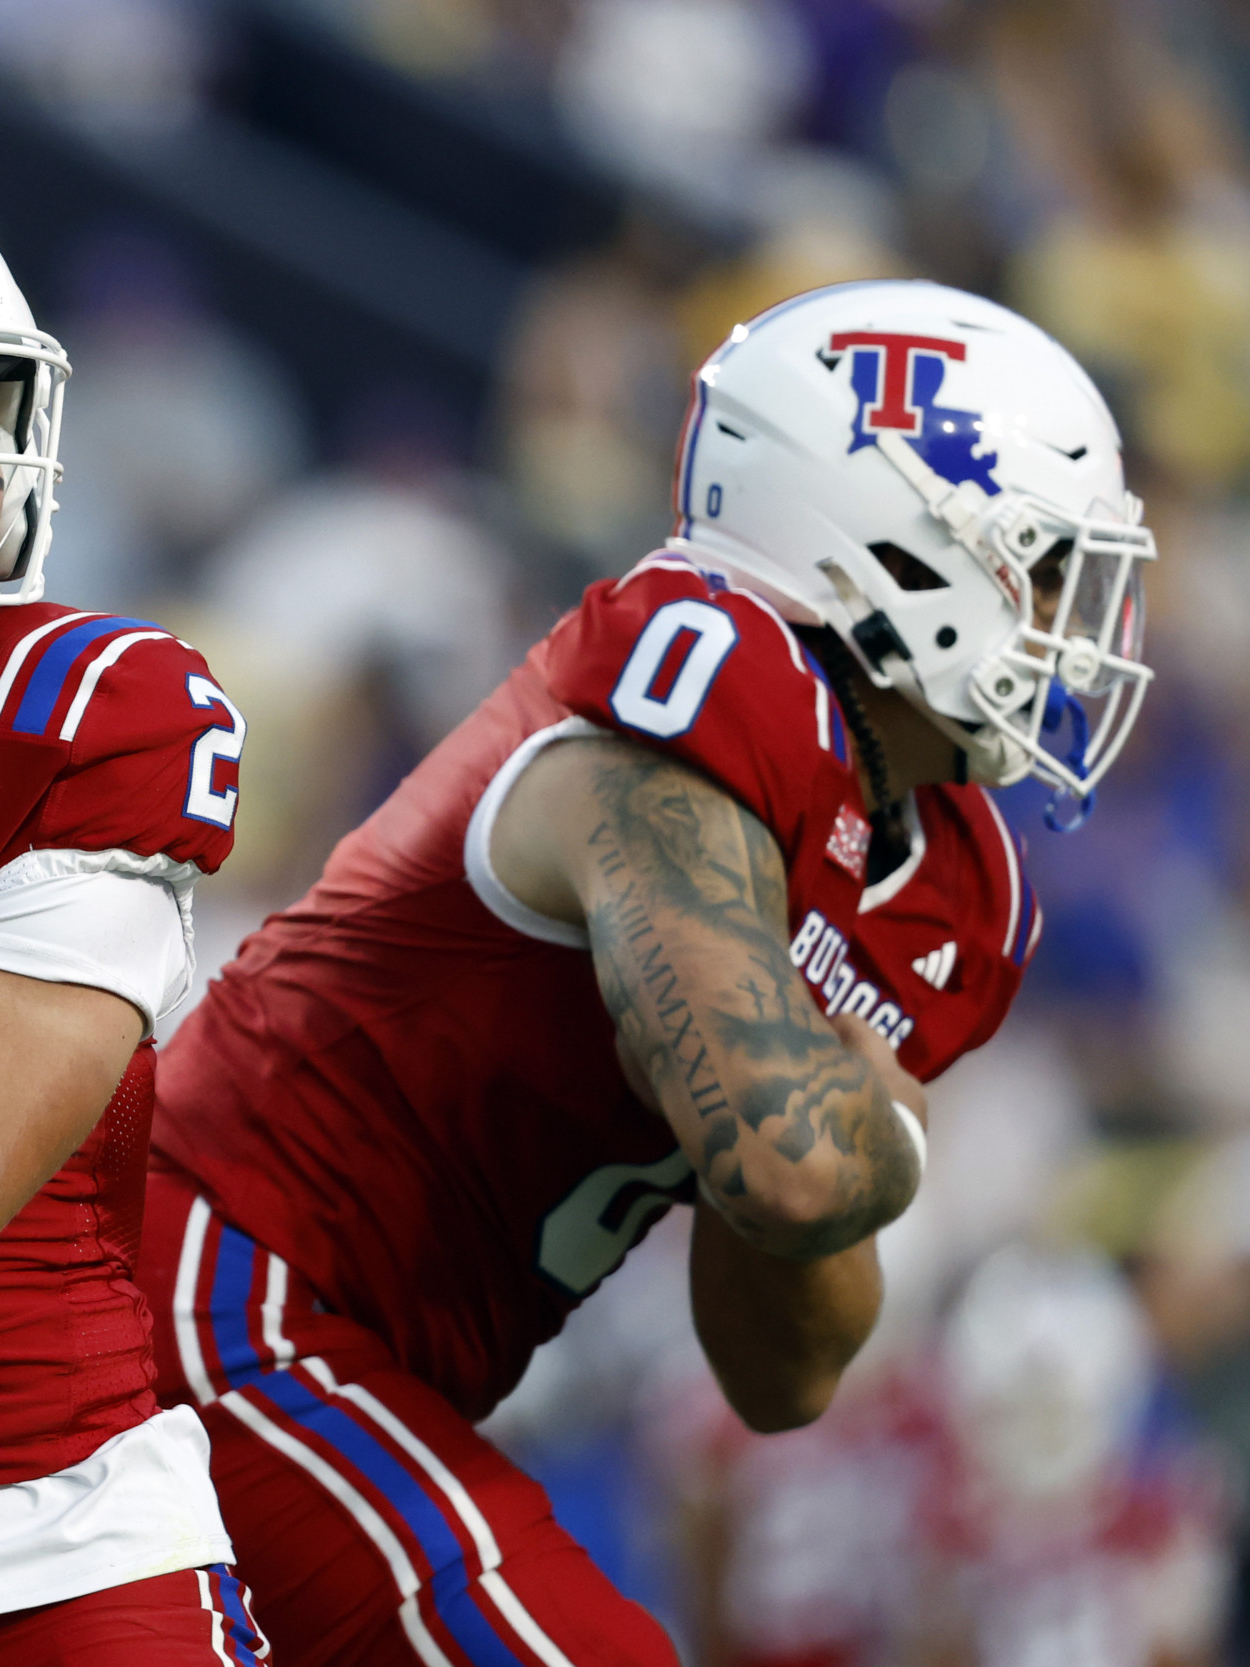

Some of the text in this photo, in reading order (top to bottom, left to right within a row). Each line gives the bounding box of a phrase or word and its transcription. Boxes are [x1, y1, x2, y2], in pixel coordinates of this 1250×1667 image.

[830, 331, 967, 432] T
[707, 484, 722, 518] 0
[608, 597, 741, 741] 0
[181, 672, 247, 832] 2
